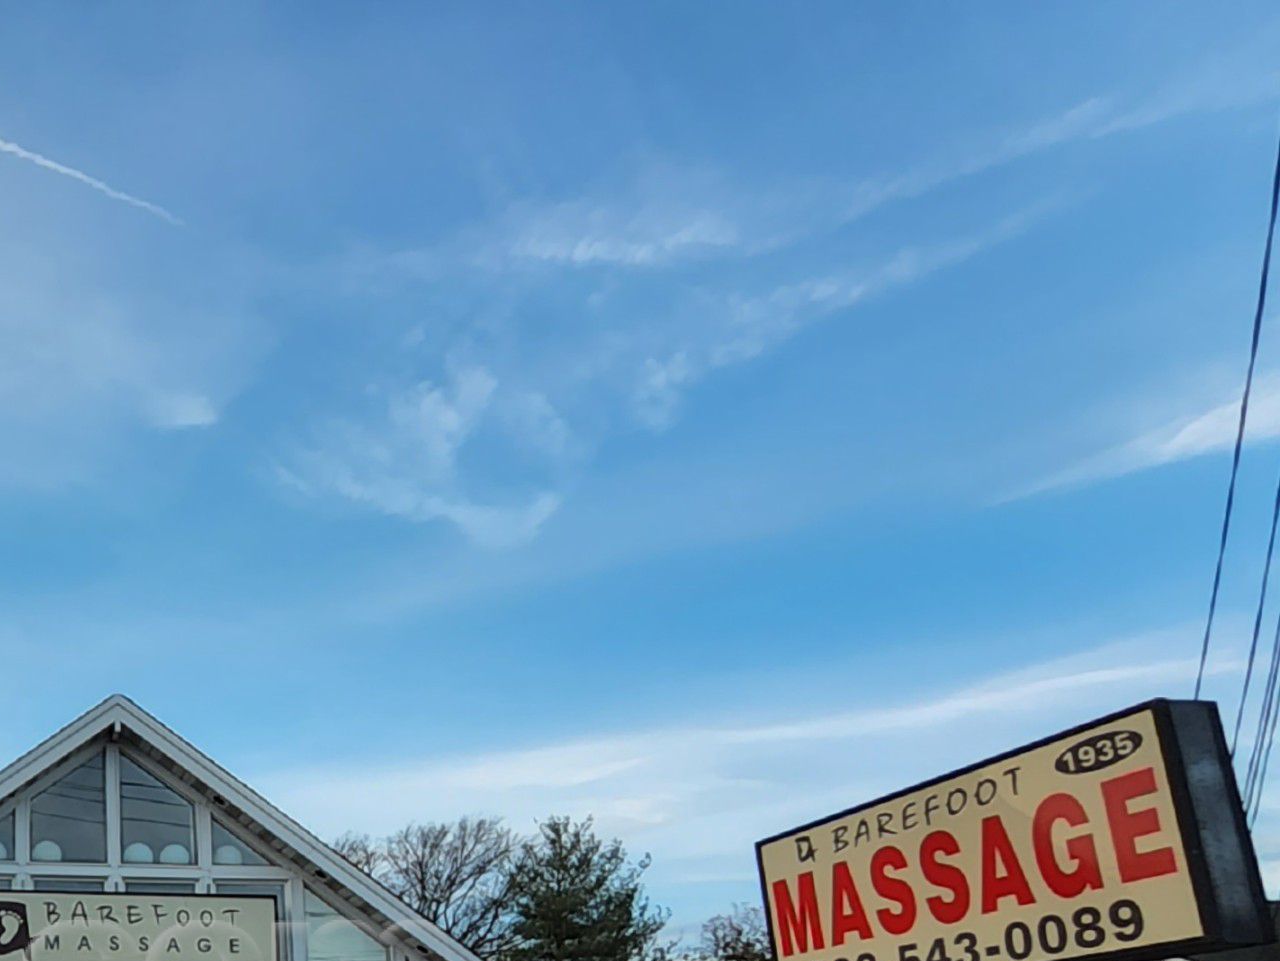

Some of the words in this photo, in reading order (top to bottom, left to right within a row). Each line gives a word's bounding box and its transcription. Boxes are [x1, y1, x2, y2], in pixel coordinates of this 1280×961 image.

[1062, 735, 1134, 772] 1935
[831, 767, 1023, 854] BAREFOOT
[772, 767, 1179, 958] MASSAGE
[43, 900, 240, 926] BAREFOOT
[44, 935, 240, 953] MASSAGE
